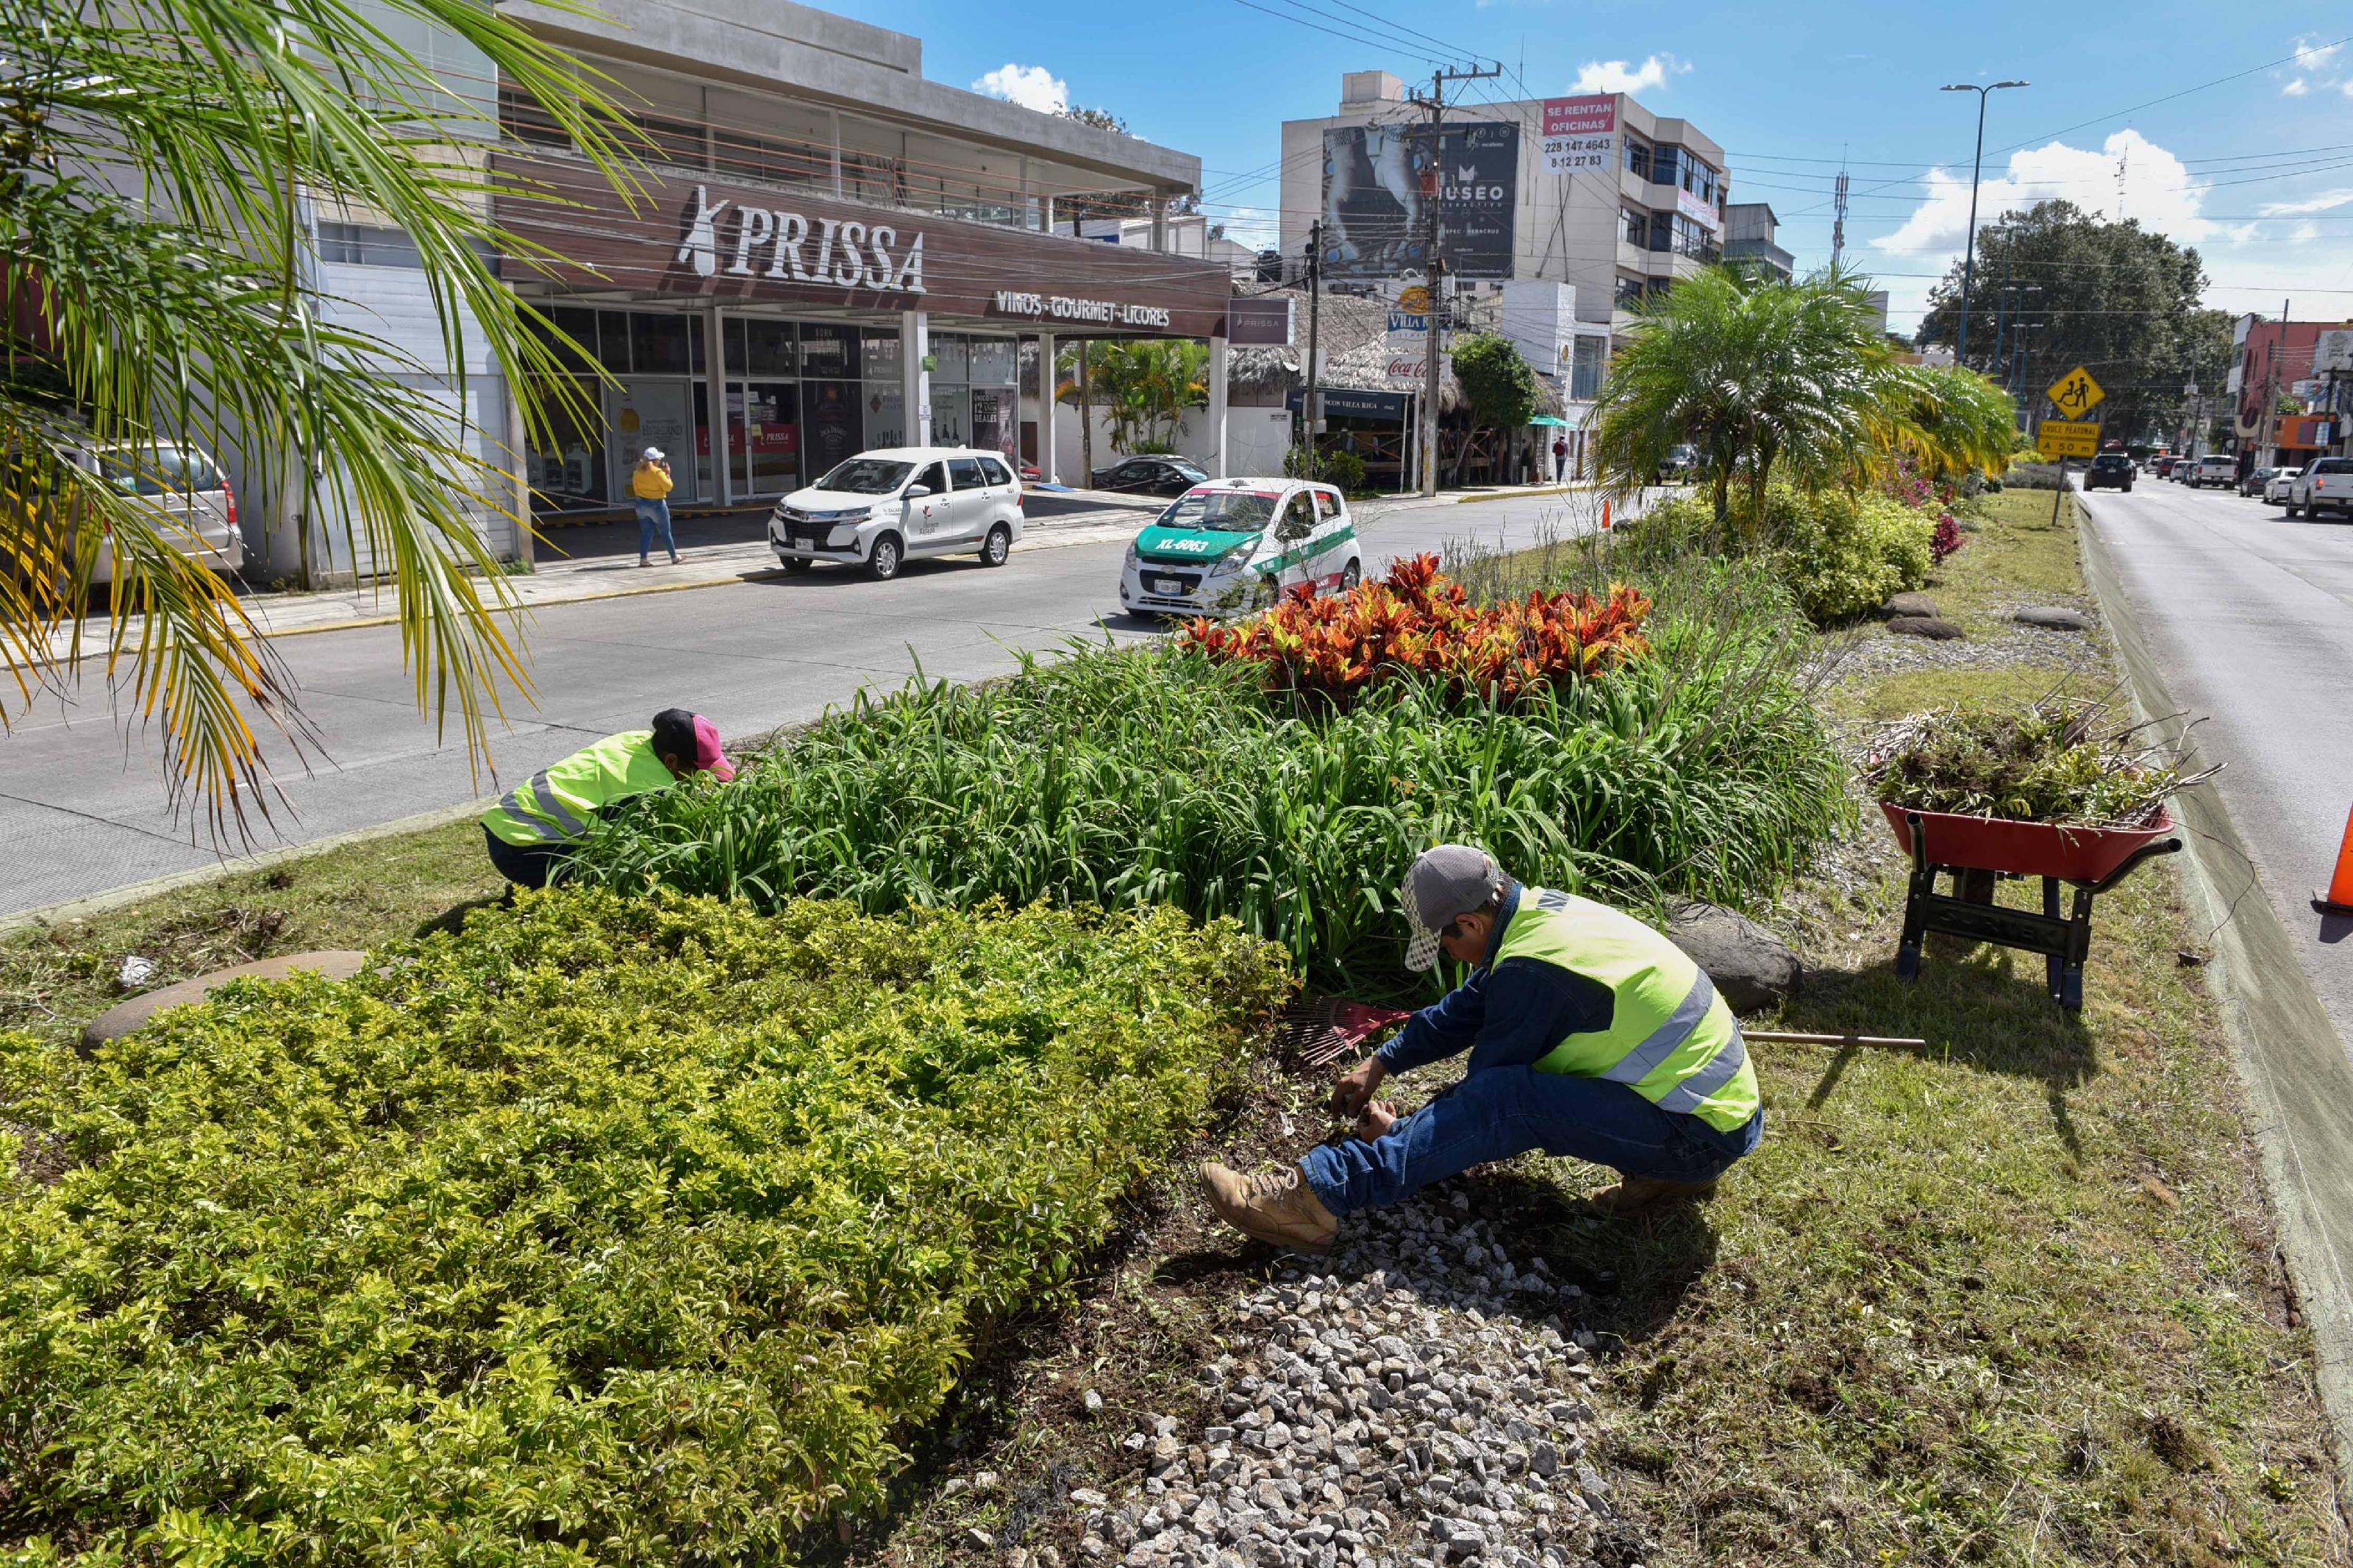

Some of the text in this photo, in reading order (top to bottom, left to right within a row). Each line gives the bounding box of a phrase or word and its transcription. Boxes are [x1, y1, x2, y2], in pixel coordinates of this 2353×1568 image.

[1547, 104, 1612, 117] SE RENTAN
[1551, 119, 1606, 132] OFICINAS
[1545, 139, 1610, 153] 228 147 4643
[1552, 154, 1602, 168] 8 12 27 83
[1438, 186, 1504, 201] USEO
[724, 204, 926, 293] PRISSA
[996, 290, 1170, 327] VINOS GOURMET LICORES
[1244, 320, 1279, 328] PRISSA
[1390, 312, 1420, 328] VILLA
[974, 414, 998, 423] REALES
[766, 432, 789, 441] PRISSA
[2042, 425, 2096, 435] CRUCE PEATONAL
[2043, 441, 2051, 450] A
[2059, 443, 2074, 451] 50
[1156, 539, 1209, 552] XL-6063
